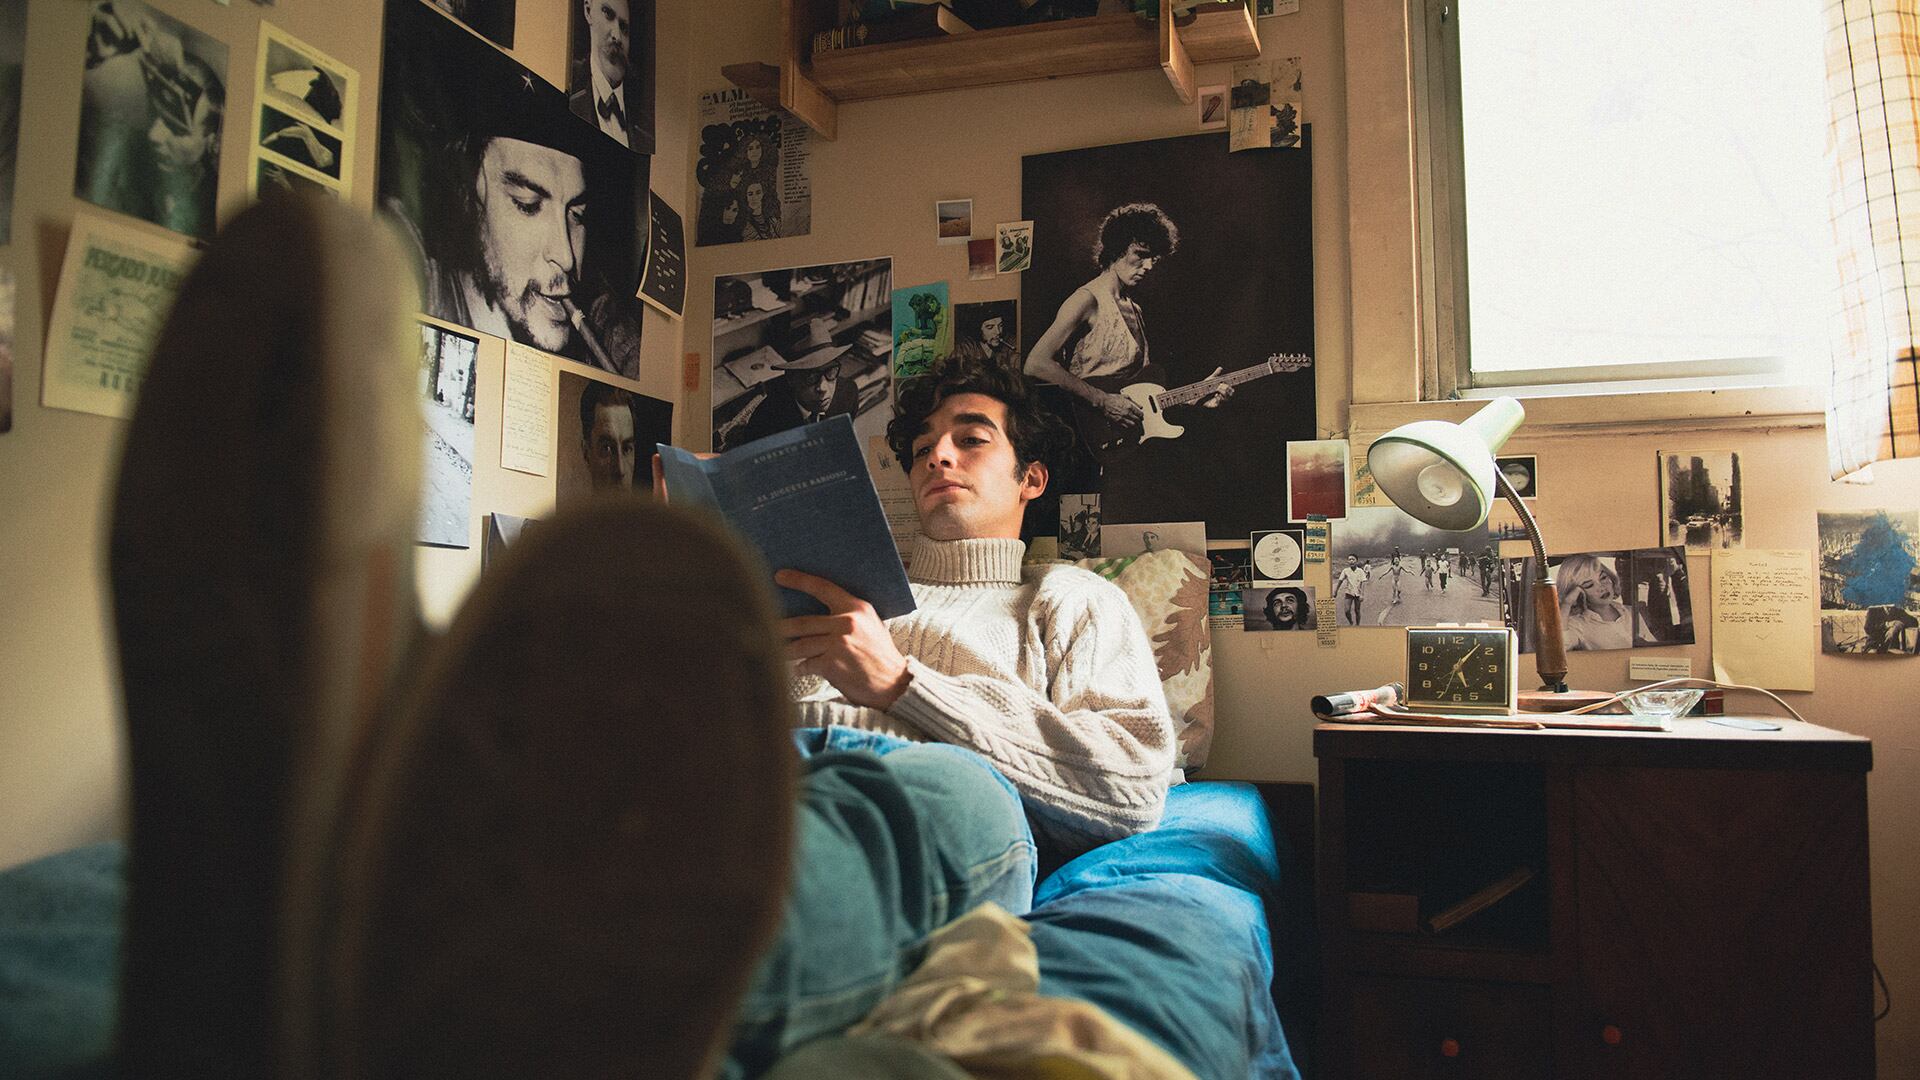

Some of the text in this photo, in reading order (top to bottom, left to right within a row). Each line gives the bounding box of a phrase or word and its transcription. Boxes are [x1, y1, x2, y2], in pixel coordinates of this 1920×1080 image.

[754, 445, 798, 464] ROBERTO
[809, 470, 847, 486] RABIOSO
[1438, 637, 1446, 645] 11
[1452, 636, 1465, 645] 12
[1422, 646, 1434, 654] 10
[1484, 647, 1494, 656] 2
[1419, 663, 1428, 671] 9
[1488, 665, 1498, 673] 3
[1422, 680, 1432, 688] 8
[1484, 682, 1493, 691] 4
[1436, 691, 1445, 699] 7
[1453, 693, 1462, 702] 6
[1469, 692, 1479, 700] 5
